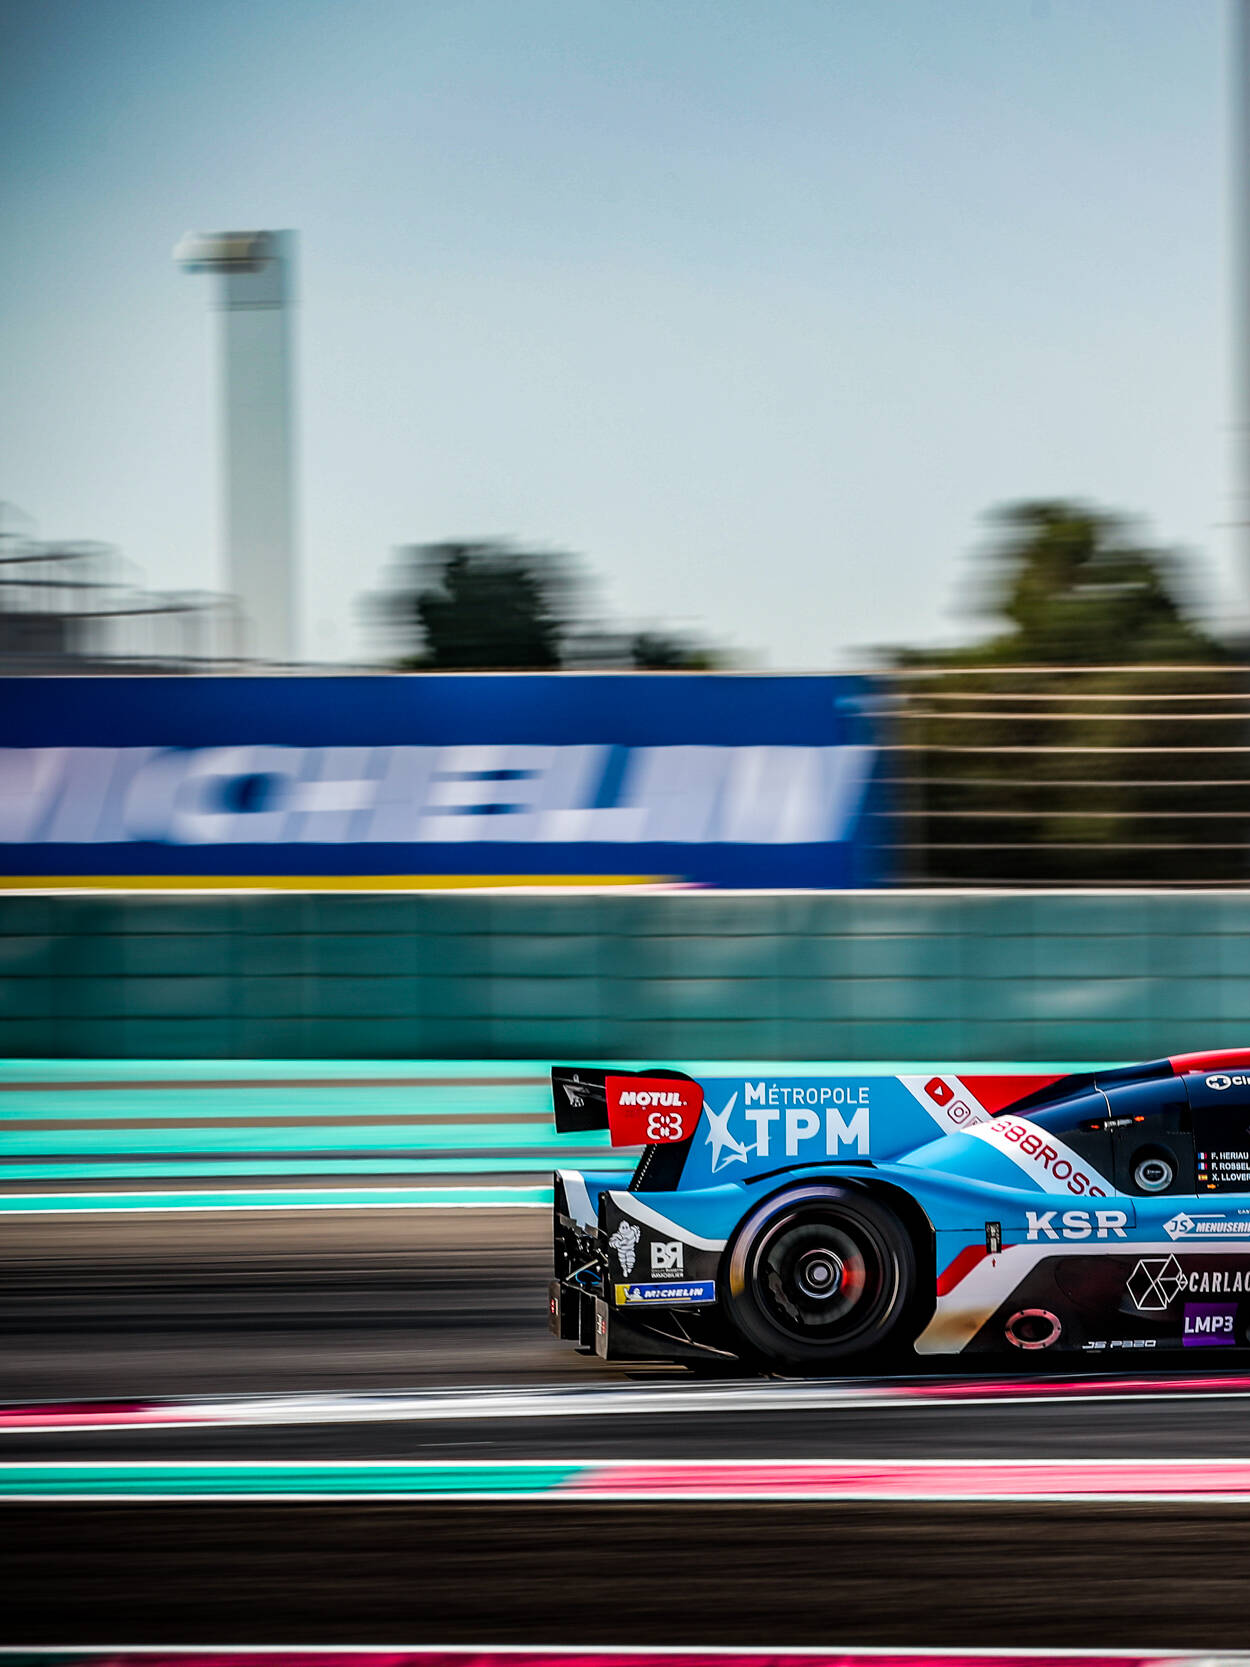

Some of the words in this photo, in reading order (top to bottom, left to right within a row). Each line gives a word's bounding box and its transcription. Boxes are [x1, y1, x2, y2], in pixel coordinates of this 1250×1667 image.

[619, 1091, 682, 1107] MOTUL
[745, 1082, 870, 1105] MÉTROPOLE
[745, 1108, 870, 1157] TPM
[1220, 1152, 1249, 1160] HERIAU
[1025, 1210, 1128, 1240] KSR
[1170, 1220, 1188, 1232] JS
[644, 1287, 704, 1299] MICHELIN
[1184, 1316, 1234, 1334] LMP3
